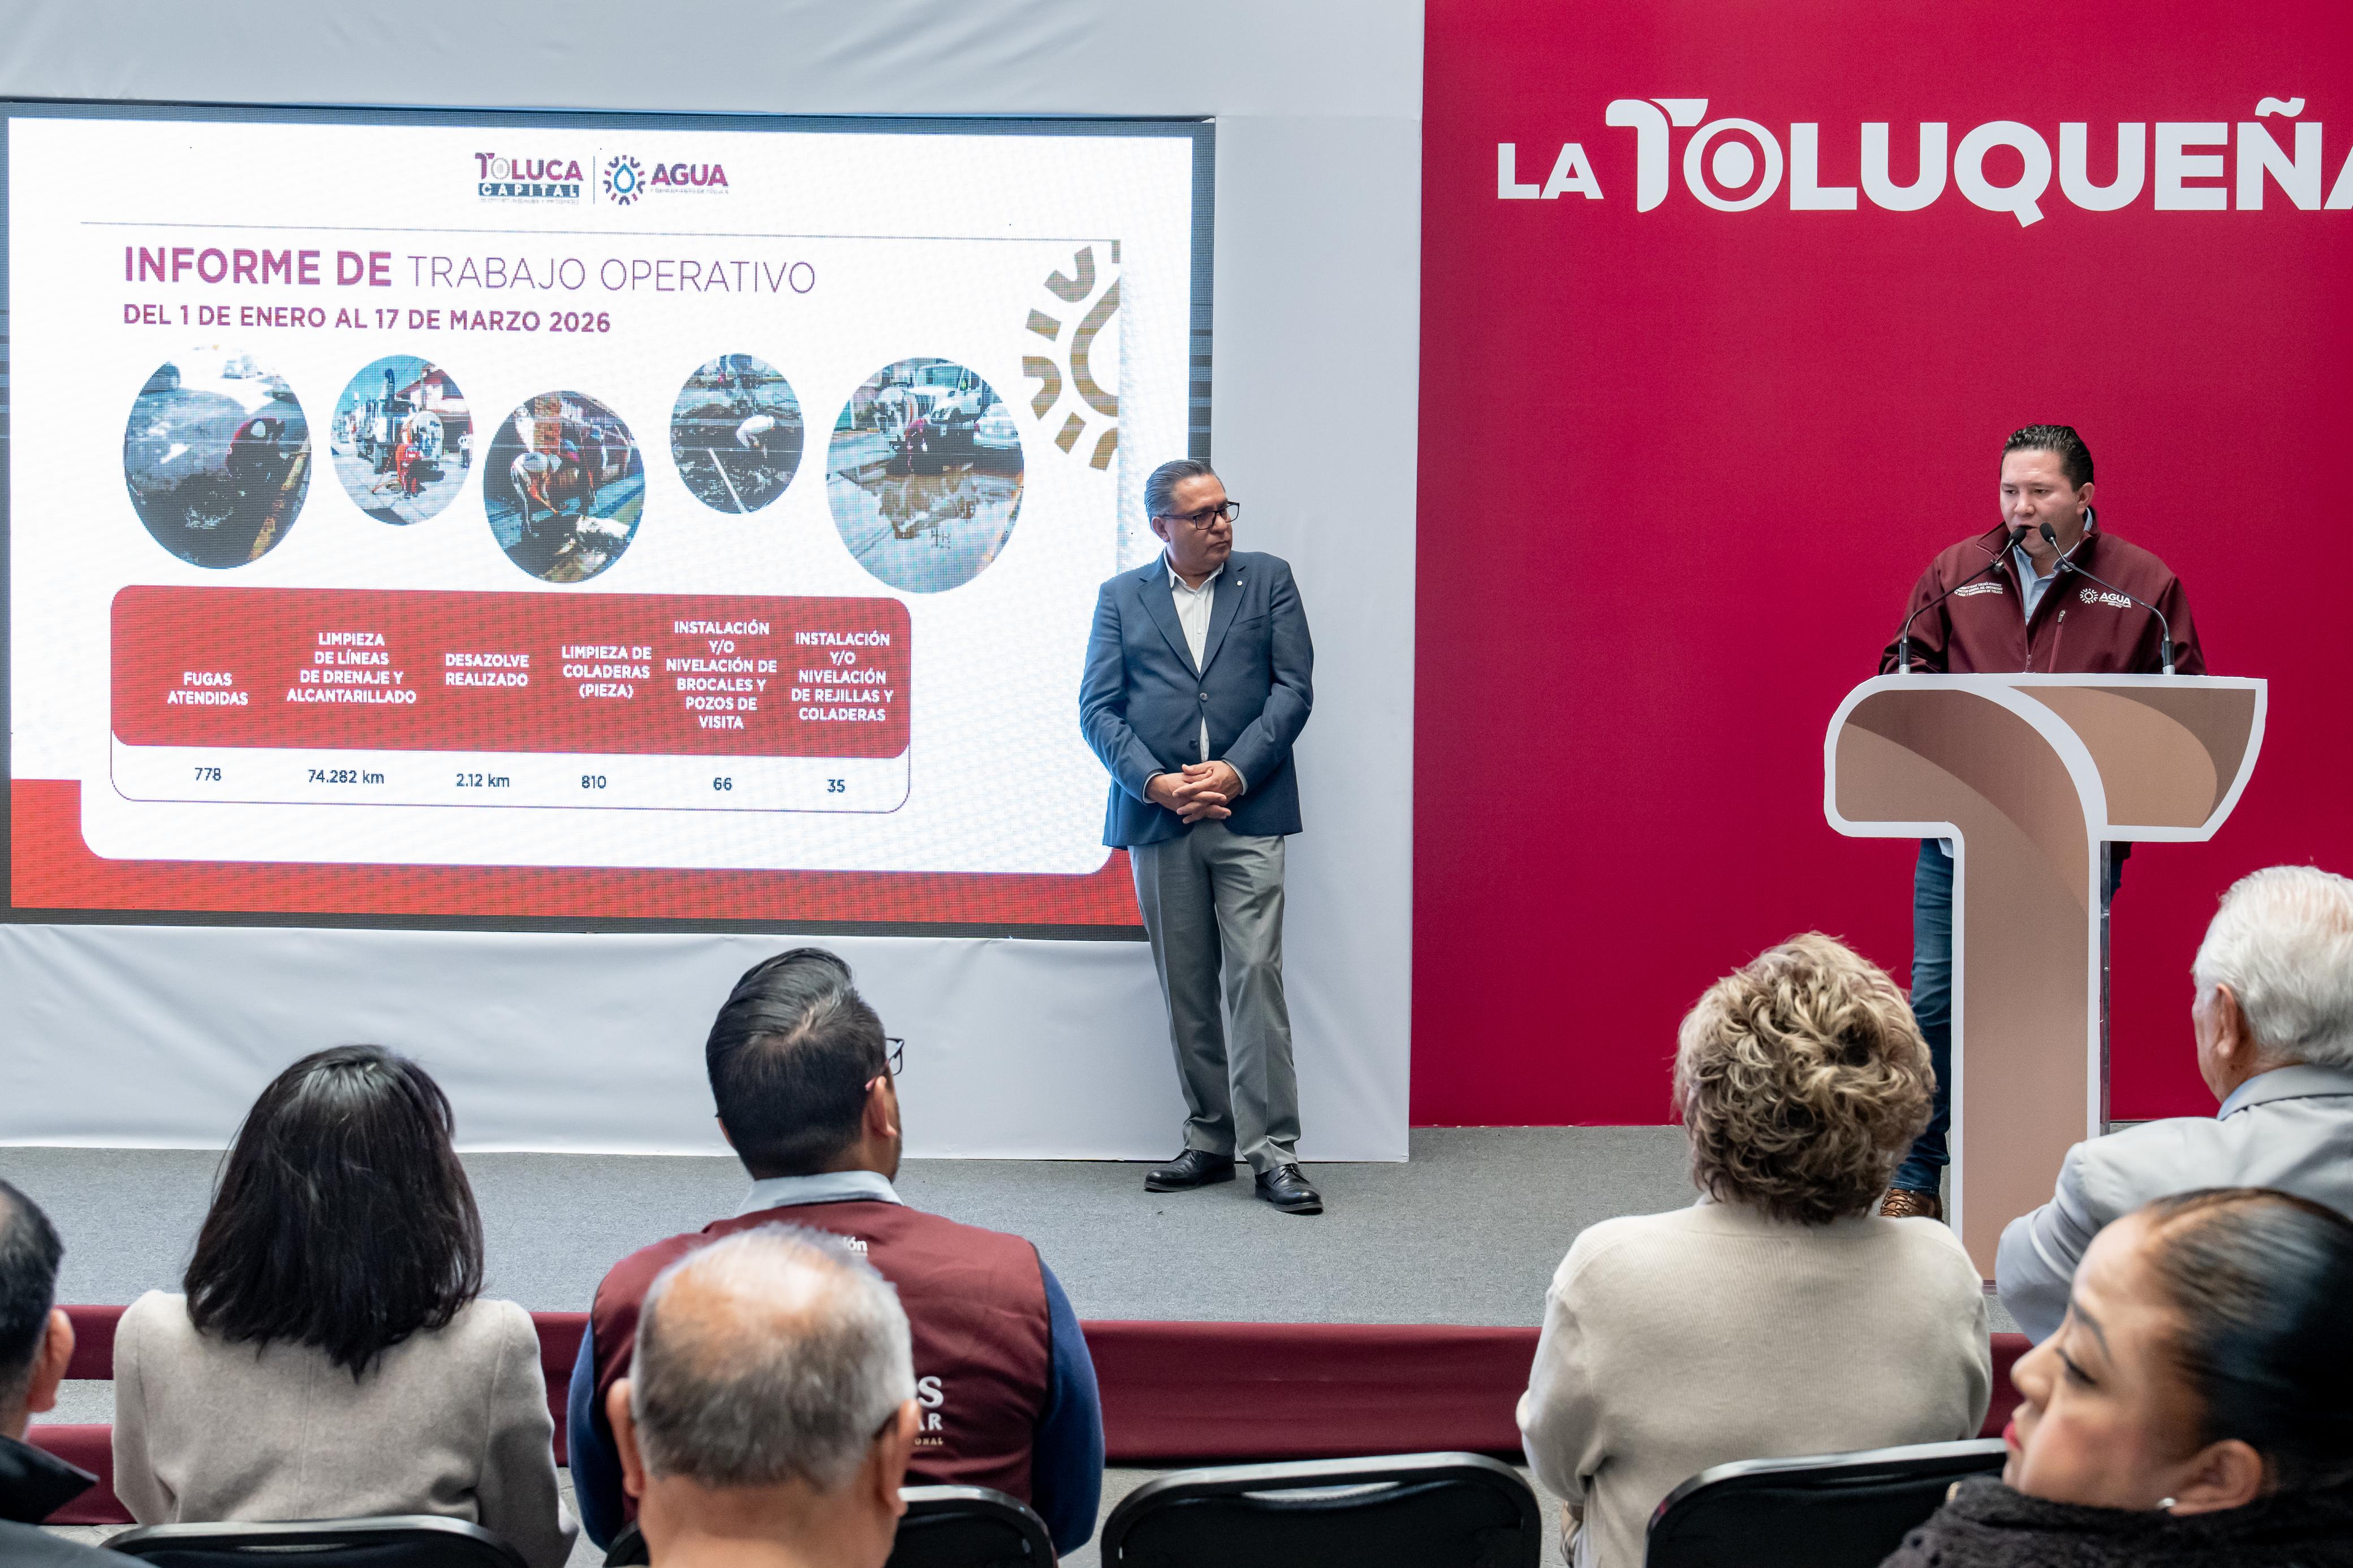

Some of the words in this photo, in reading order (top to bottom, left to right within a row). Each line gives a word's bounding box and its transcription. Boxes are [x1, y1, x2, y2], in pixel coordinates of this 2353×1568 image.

[475, 152, 583, 180] TOLUCA
[1498, 144, 1604, 199] LA
[651, 163, 729, 186] AGUA
[481, 184, 578, 196] CAPITAL
[126, 247, 320, 285] INFORME
[337, 250, 391, 287] DE
[407, 256, 585, 290] TRABAJO
[601, 259, 815, 293] OPERATIVO
[124, 304, 171, 325] DEL
[180, 305, 188, 325] 1
[199, 305, 230, 326] DE
[241, 306, 326, 327] ENERO
[335, 308, 368, 329] AL
[376, 309, 399, 329] 17
[409, 309, 440, 330] DE
[450, 310, 540, 331] MARZO
[549, 312, 610, 332] 2026
[2100, 592, 2131, 605] AGUA
[674, 619, 769, 635] INSTALACIÓN
[318, 633, 385, 646] LIMPIEZA
[796, 630, 890, 646] INSTALACIÓN
[562, 645, 629, 659] LIMPIEZA
[632, 646, 652, 660] DE
[708, 639, 735, 654] Y/O
[314, 651, 334, 664] DE
[338, 649, 389, 665] LÍNEAS
[446, 653, 529, 668] DESAZOLVE
[666, 656, 753, 672] NIVELACIÓN
[758, 660, 777, 673] DE
[830, 650, 856, 666] Y/O
[184, 672, 232, 686] FUGAS
[300, 669, 320, 683] DE
[323, 669, 390, 684] DRENAJE
[393, 671, 404, 684] Y
[446, 672, 529, 686] REALIZADO
[563, 664, 650, 679] COLADERAS
[799, 667, 886, 684] NIVELACIÓN
[579, 684, 634, 699] (PIEZA)
[677, 677, 753, 692] BROCALES
[757, 679, 766, 692] Y
[167, 690, 248, 706] ATENDIDAS
[287, 688, 416, 703] ALCANTARILLADO
[791, 688, 811, 702] DE
[815, 689, 880, 703] REJILLAS
[884, 690, 894, 702] Y
[686, 696, 734, 710] POZOS
[738, 697, 757, 711] DE
[699, 715, 744, 729] VISITA
[799, 707, 885, 722] COLADERAS
[195, 767, 222, 781] 778
[308, 769, 357, 783] 74.282
[363, 770, 384, 784] km
[456, 773, 482, 787] 2.12
[488, 774, 510, 787] km
[581, 775, 606, 789] 810
[713, 777, 732, 791] 66
[827, 779, 846, 793] 35
